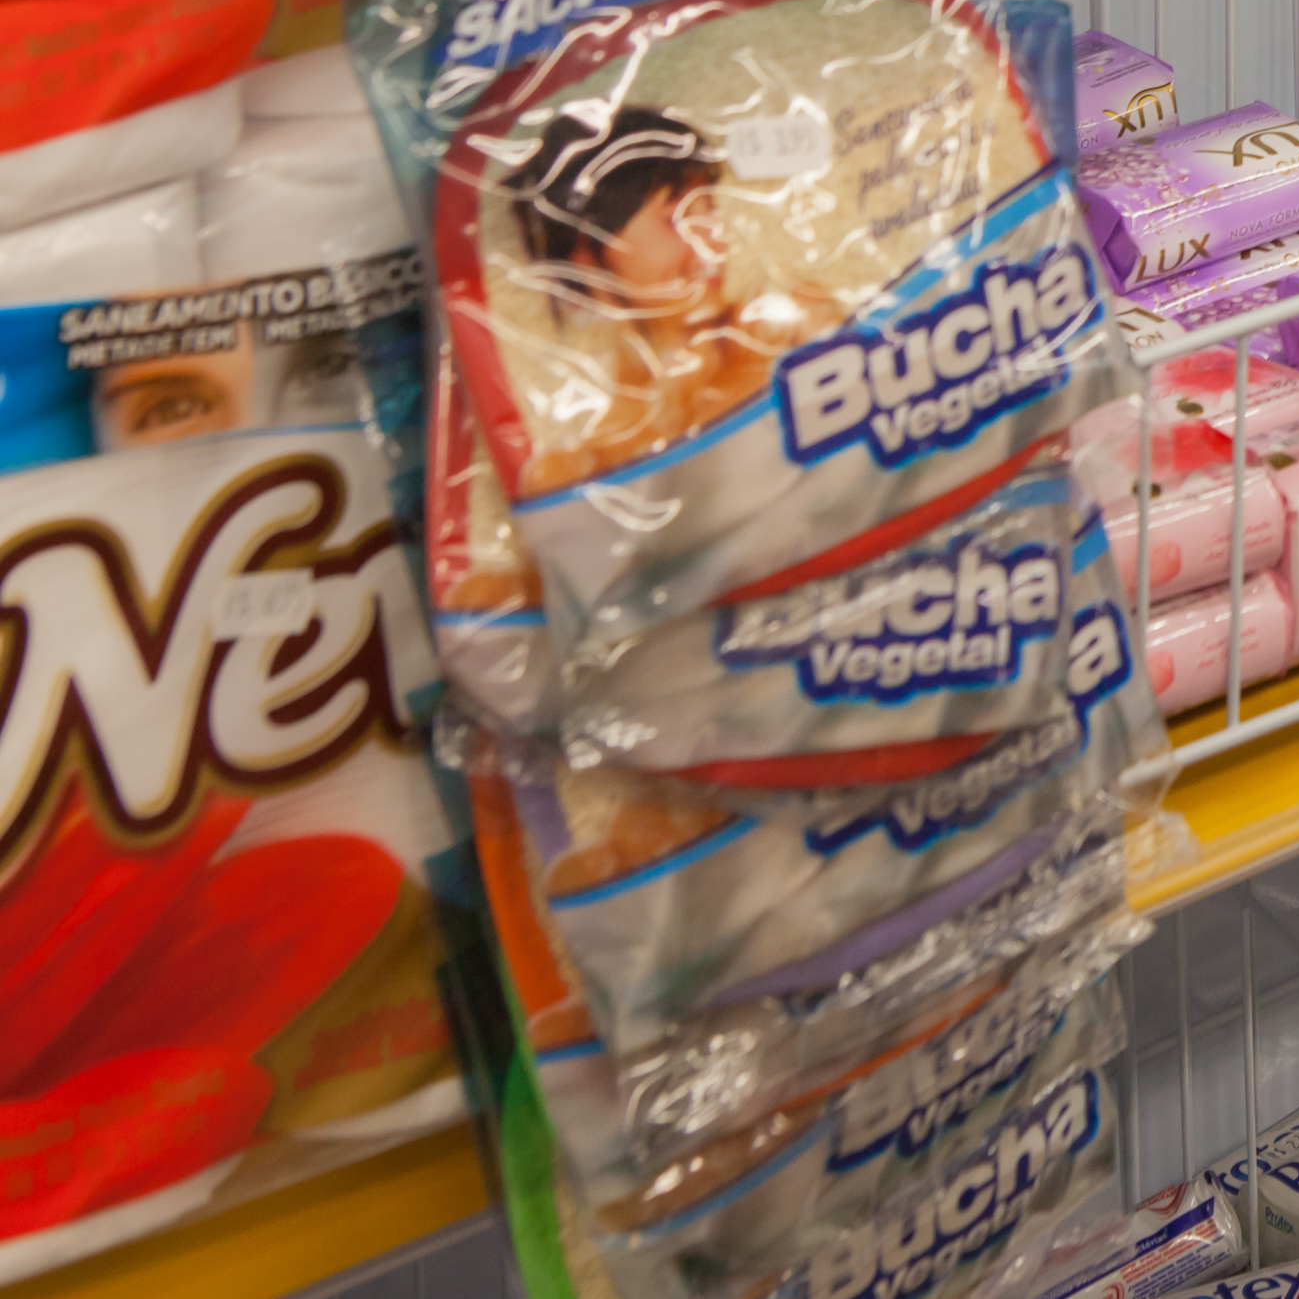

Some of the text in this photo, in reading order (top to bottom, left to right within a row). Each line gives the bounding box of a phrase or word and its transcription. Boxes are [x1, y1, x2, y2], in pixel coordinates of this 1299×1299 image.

[1102, 81, 1178, 139] LUX
[1229, 220, 1264, 241] NOVA
[787, 246, 1090, 452] Bucha
[873, 344, 1065, 453] Vegetal
[720, 546, 1061, 660] ucha
[808, 622, 1010, 688] Vegetal
[0, 455, 424, 862] Ne
